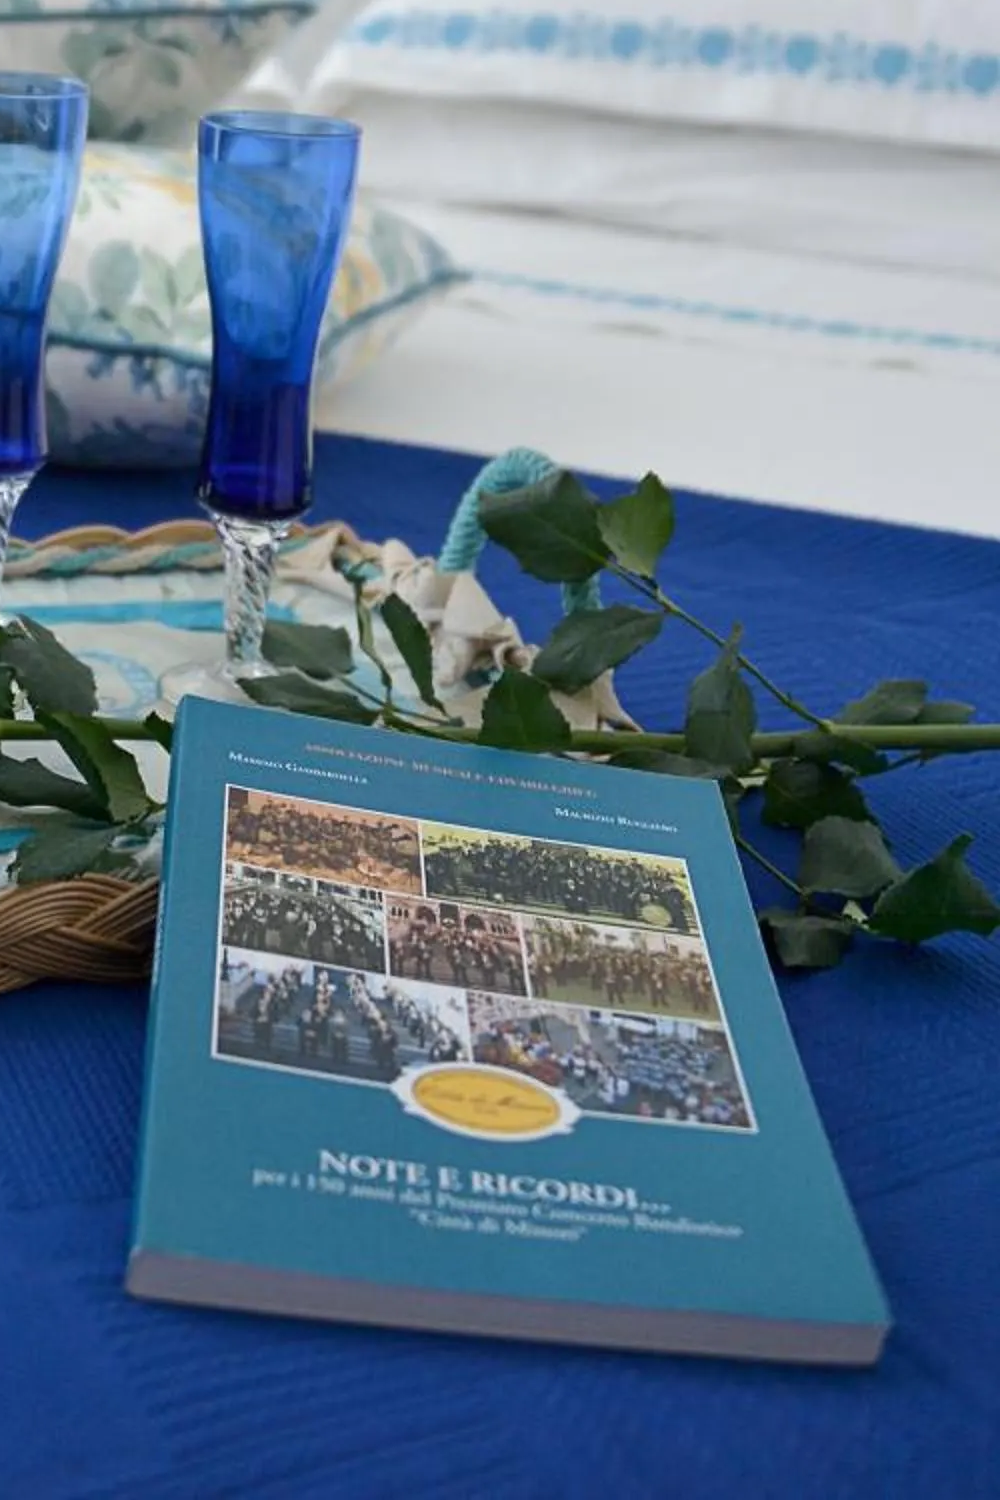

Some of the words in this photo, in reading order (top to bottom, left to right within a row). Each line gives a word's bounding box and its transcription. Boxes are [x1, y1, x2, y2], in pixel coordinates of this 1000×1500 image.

[252, 1168, 286, 1189] per
[319, 1149, 430, 1187] NOTE
[437, 1165, 463, 1192] E
[471, 1169, 672, 1213] RICORDI...
